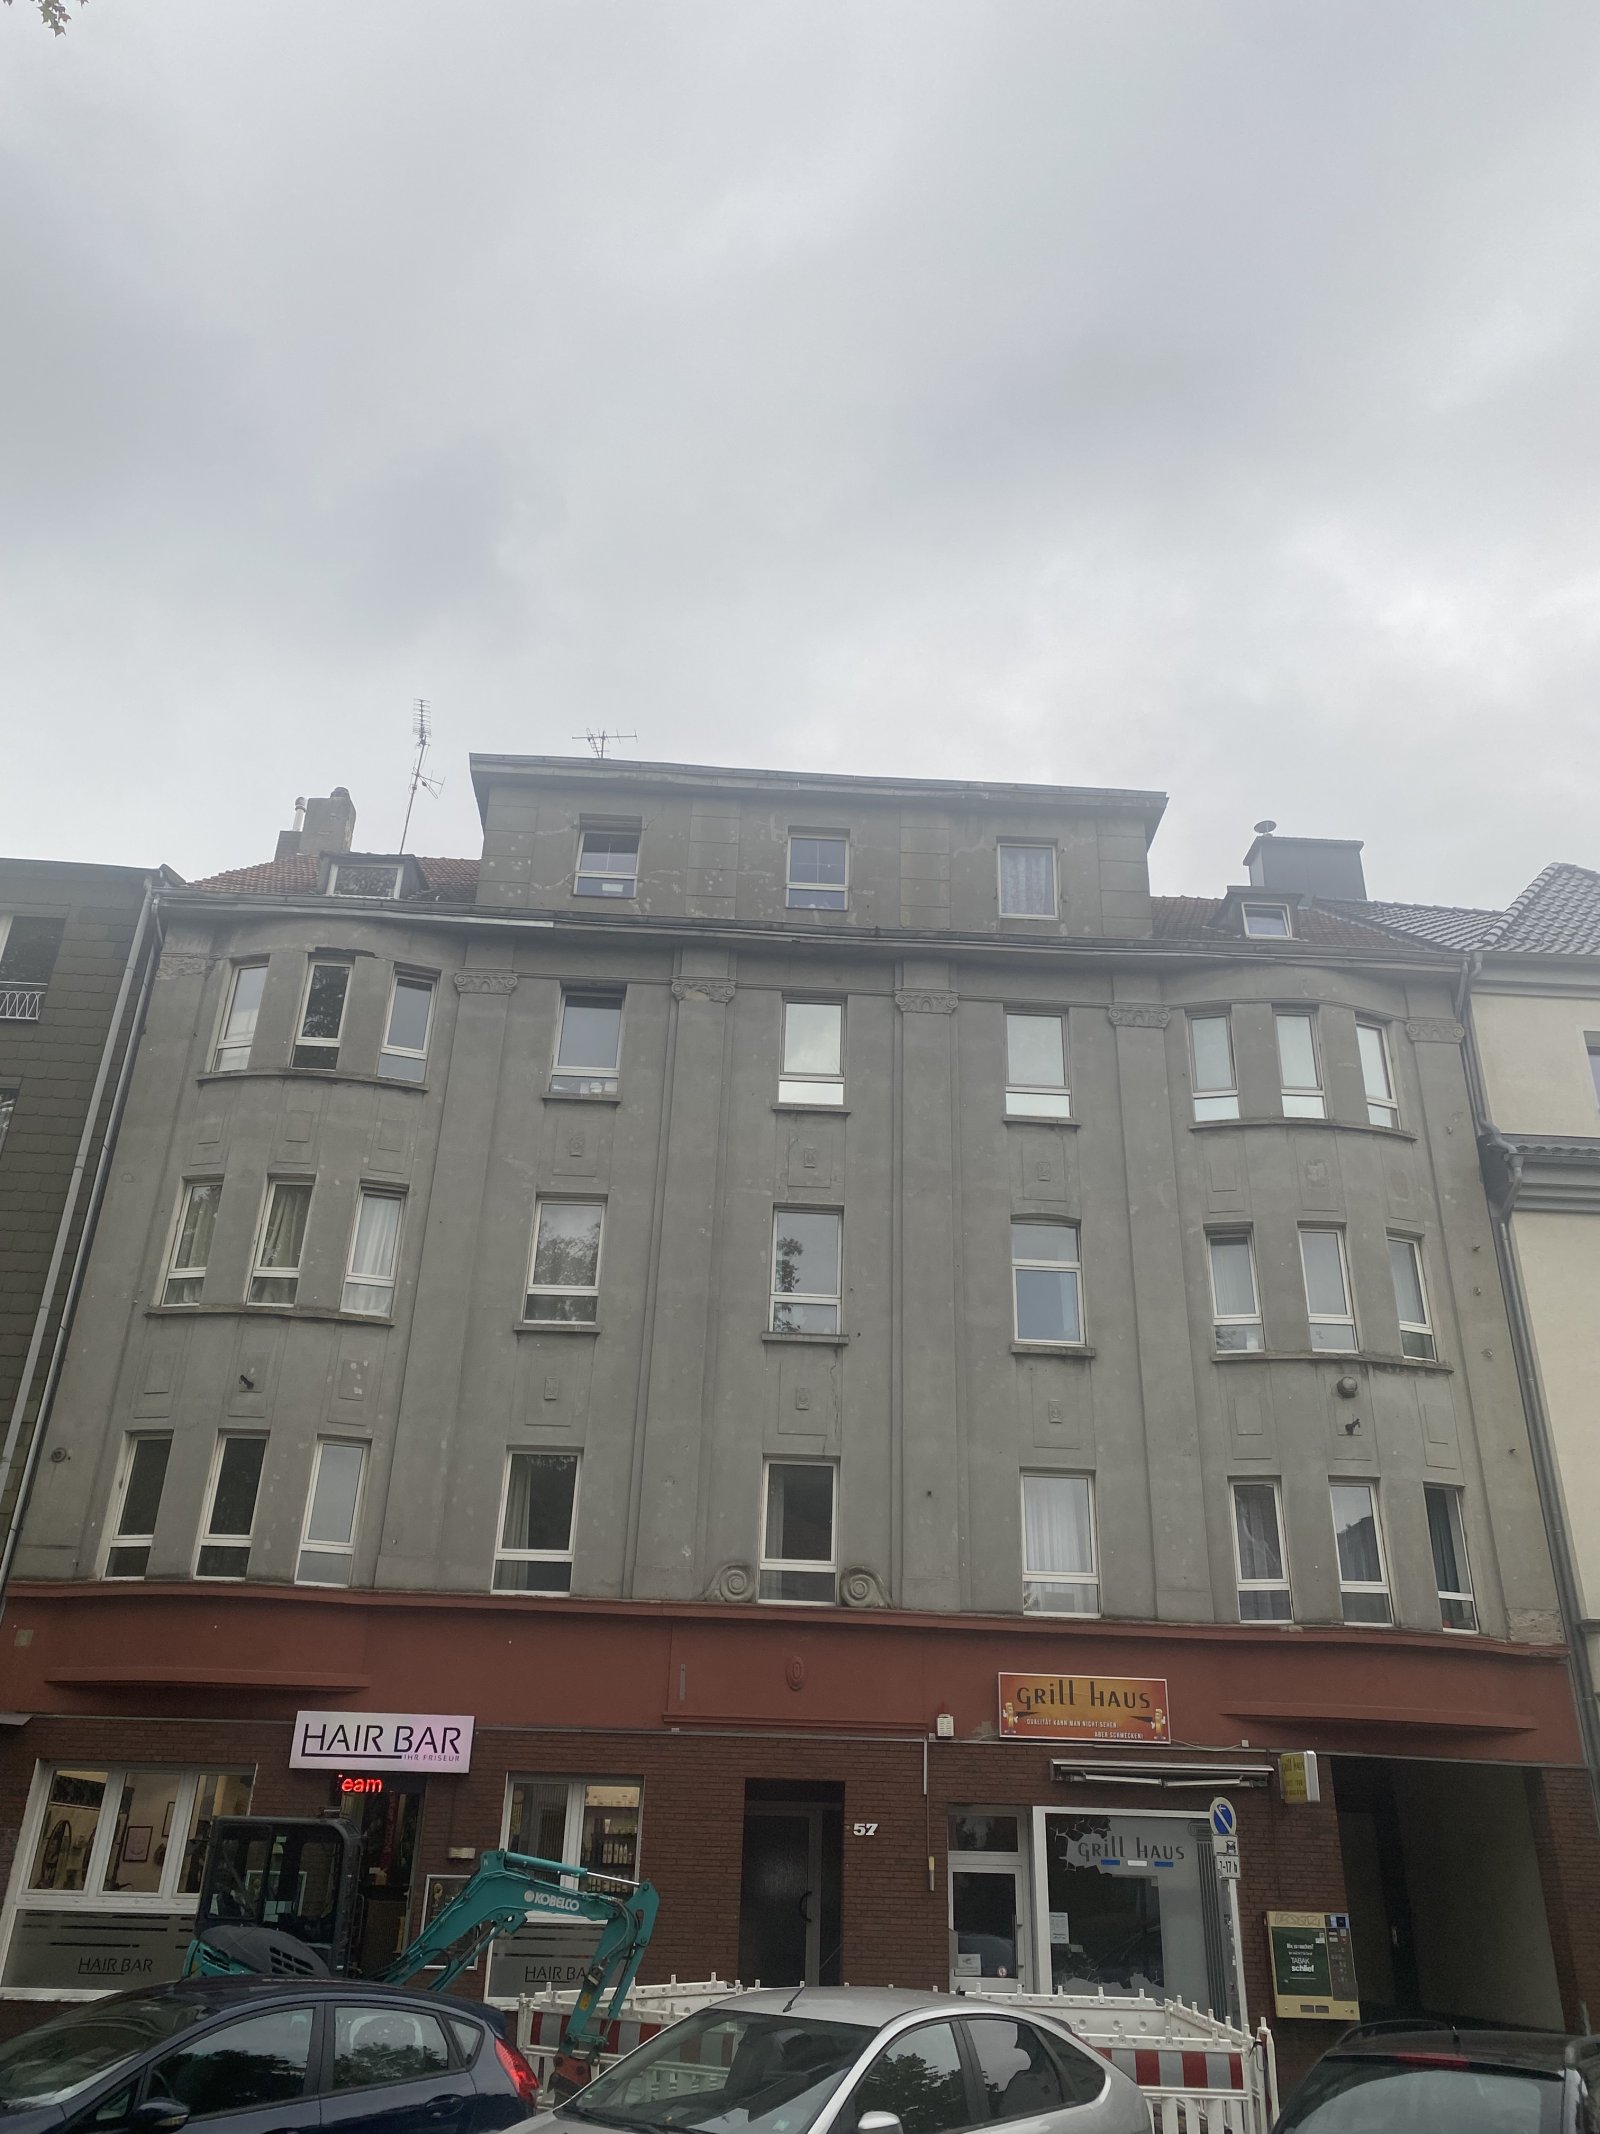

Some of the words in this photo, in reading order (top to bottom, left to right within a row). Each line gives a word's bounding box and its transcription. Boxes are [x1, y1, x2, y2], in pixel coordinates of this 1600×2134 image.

[301, 1723, 384, 1756] HAIR
[393, 1725, 462, 1755] BAR
[1094, 1731, 1109, 1739] ABER
[422, 1754, 460, 1762] FRISEUR
[338, 1774, 383, 1793] eam
[853, 1823, 879, 1836] 57
[534, 1892, 580, 1911] KOBELCO
[78, 1957, 118, 1974] HAIR
[120, 1958, 153, 1973] BAR
[1290, 1957, 1310, 1966] TABAK
[525, 1965, 562, 1982] HAIR
